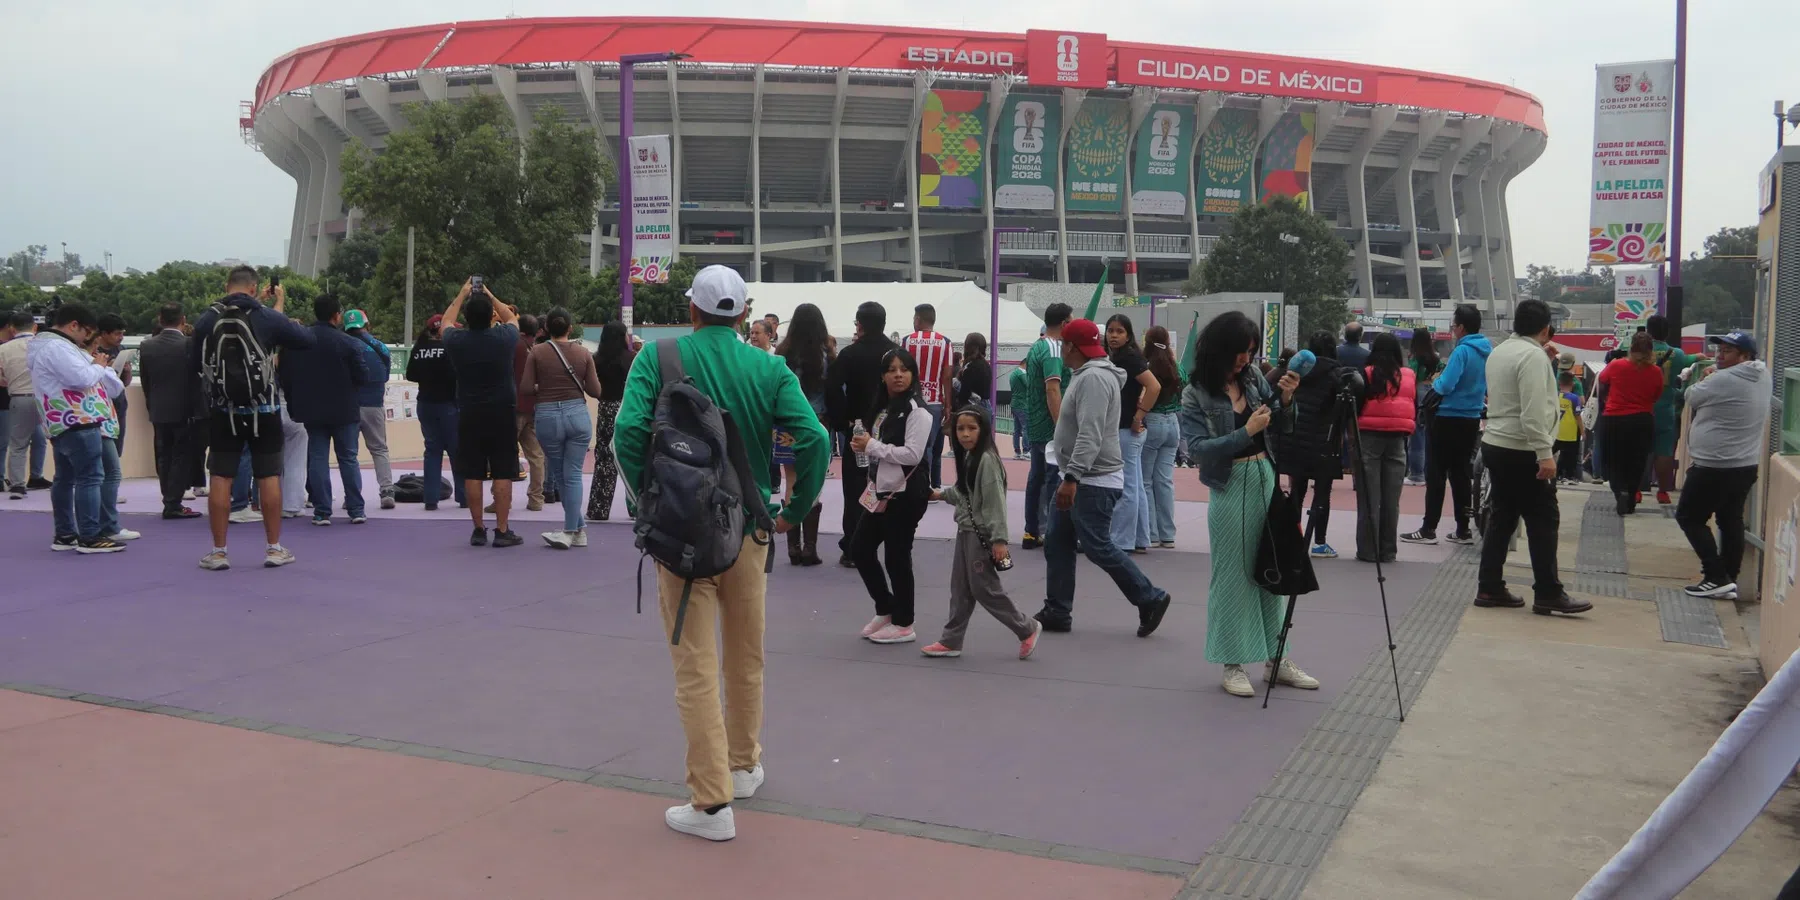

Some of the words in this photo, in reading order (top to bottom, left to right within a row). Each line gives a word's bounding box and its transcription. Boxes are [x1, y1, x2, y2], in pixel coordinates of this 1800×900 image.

[908, 46, 1013, 66] ESTADIO
[1138, 59, 1230, 82] CIUDAD
[1240, 68, 1271, 85] DE
[1280, 70, 1362, 94] MÉXICO
[1012, 154, 1042, 164] COPA
[1011, 171, 1042, 179] 2026
[1148, 167, 1175, 175] 2026
[1072, 182, 1090, 191] WE
[1093, 183, 1117, 192] ARE
[1596, 180, 1612, 190] LA
[1615, 179, 1664, 190] PELOTA
[1363, 316, 1383, 325] 2026
